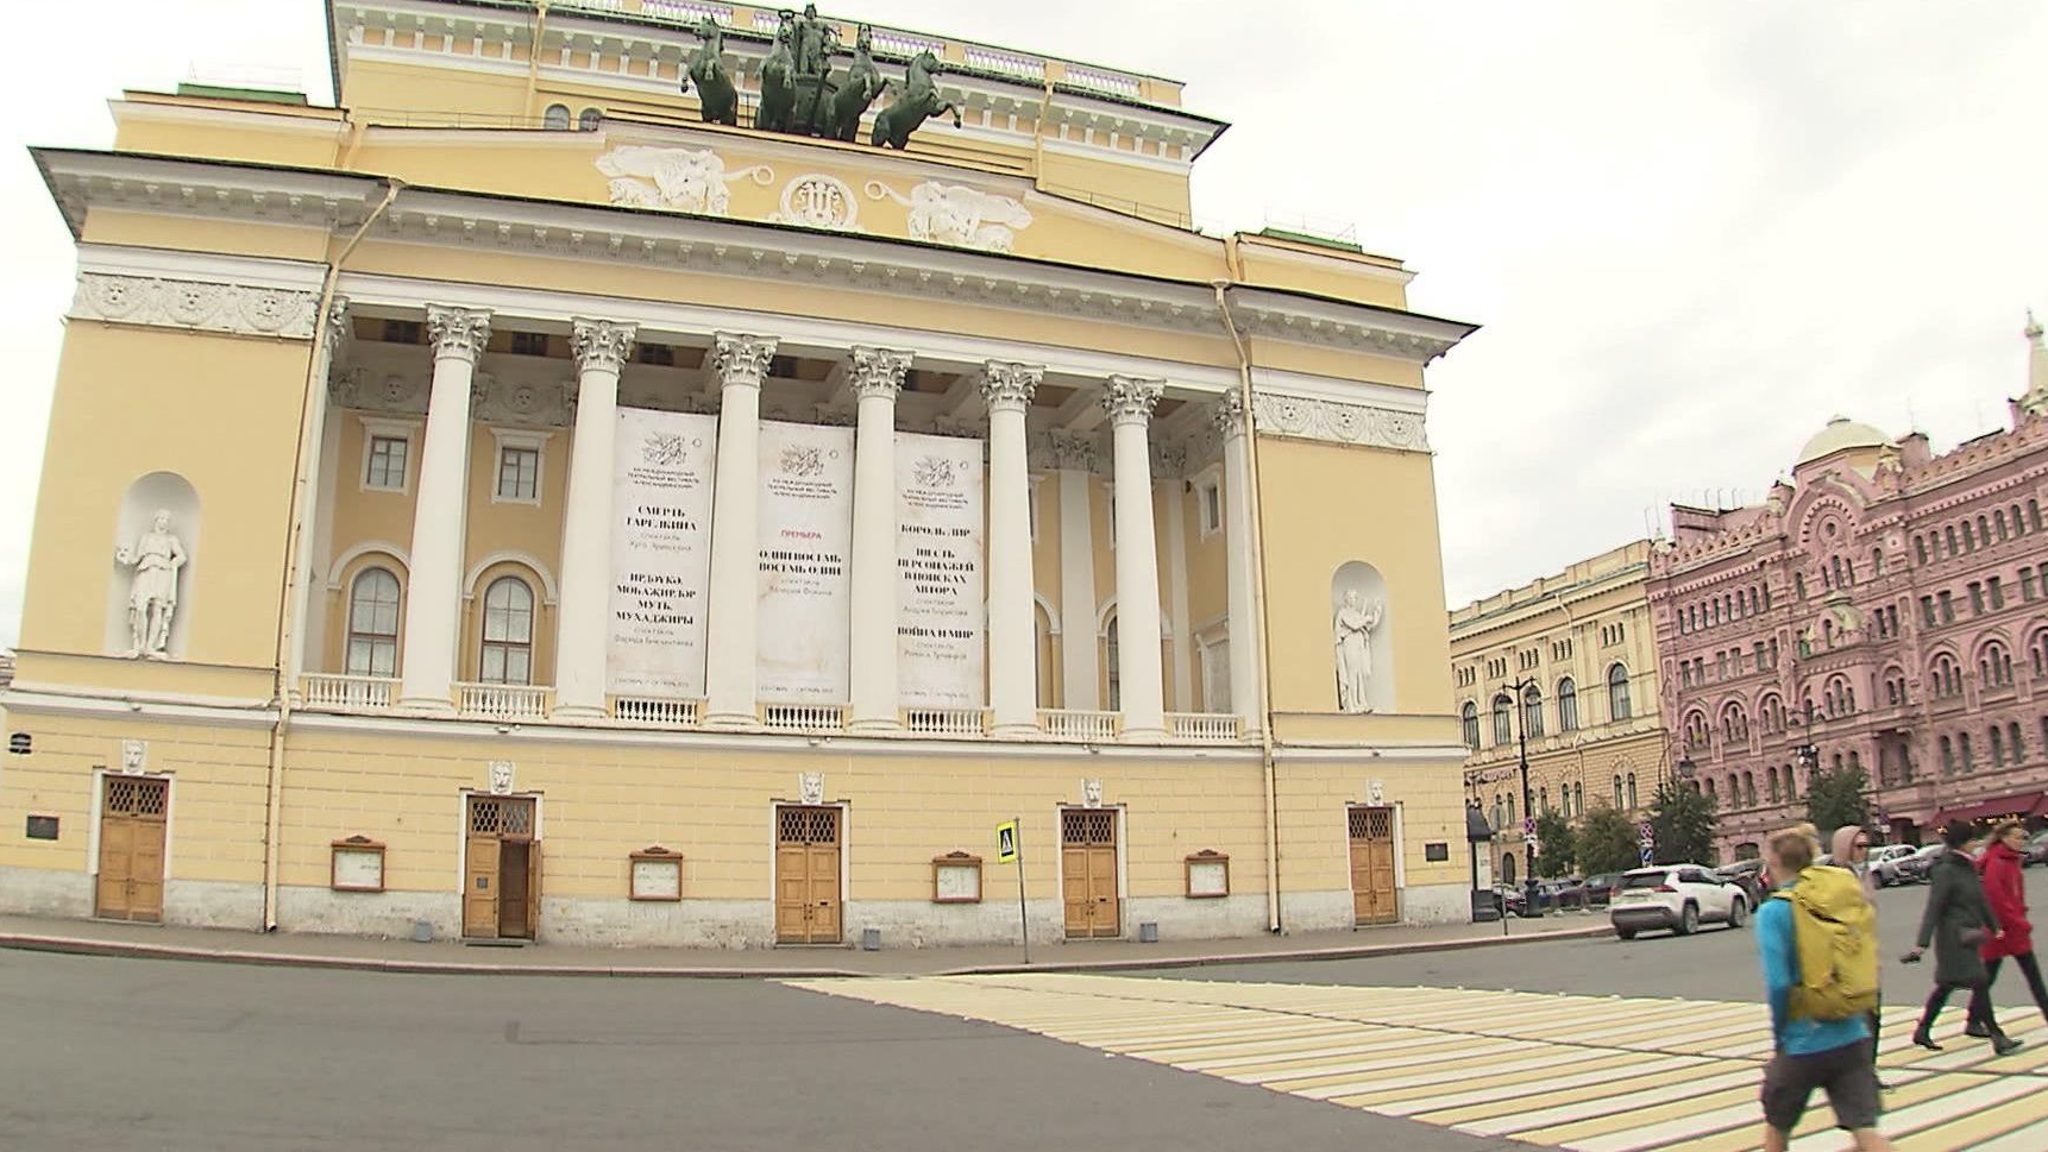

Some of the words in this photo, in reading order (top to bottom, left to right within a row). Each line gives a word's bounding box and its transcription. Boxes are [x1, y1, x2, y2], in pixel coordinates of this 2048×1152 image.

[638, 506, 685, 518] СМЕРТЬ
[626, 517, 697, 531] ТАРЕЛКИНА
[901, 524, 945, 536] КОРОЛЬ
[947, 528, 970, 537] ЛИР
[780, 530, 822, 540] ПРЕМЬЕРА
[916, 548, 955, 558] ШЕСТЬ
[897, 558, 974, 571] ПЕРСОНАЖЕЙ
[915, 585, 958, 595] АВТОРА
[616, 611, 694, 625] МУХАДЖИРЫ
[897, 625, 936, 638] ВОЙНА
[937, 630, 947, 638] И
[949, 630, 974, 639] МИР
